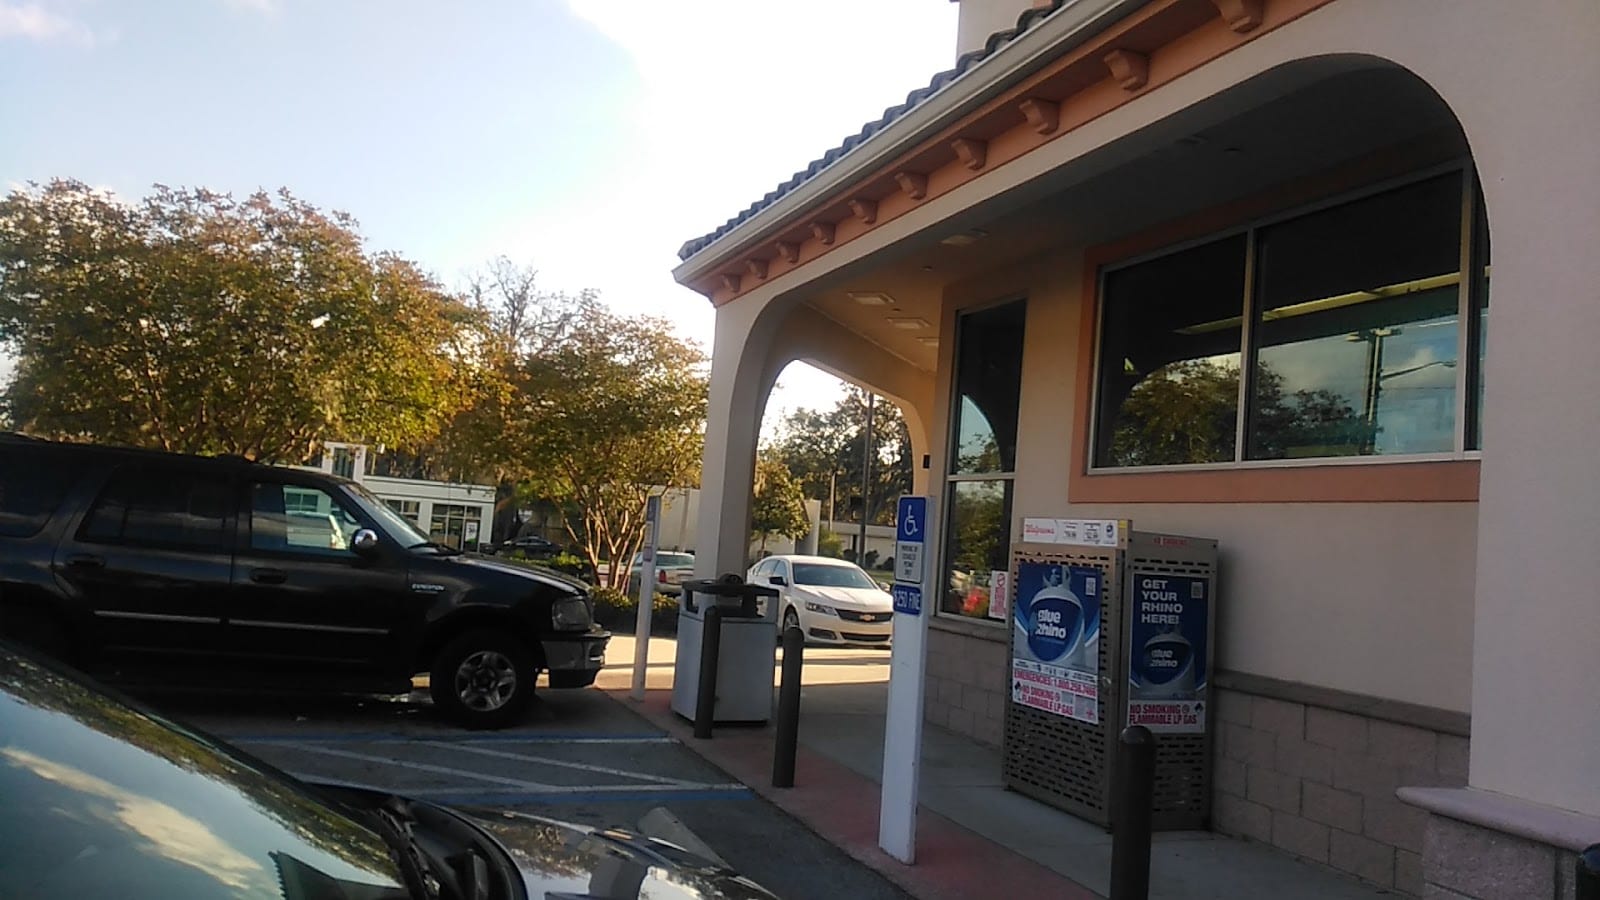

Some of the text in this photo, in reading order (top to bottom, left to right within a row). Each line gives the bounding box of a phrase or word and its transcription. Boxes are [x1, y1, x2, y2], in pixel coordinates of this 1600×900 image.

[1142, 579, 1168, 590] GET
[908, 592, 921, 610] FINE
[1141, 590, 1178, 602] YOUR
[1141, 602, 1184, 614] RHINO
[1141, 614, 1180, 625] HERE!
[1031, 686, 1055, 701] SMOKING
[1022, 694, 1053, 711] FLAMMABLE
[1062, 704, 1074, 716] GAS
[1130, 704, 1181, 714] NO SMOKING
[1130, 714, 1197, 724] FLAMMABLE LP GAS
